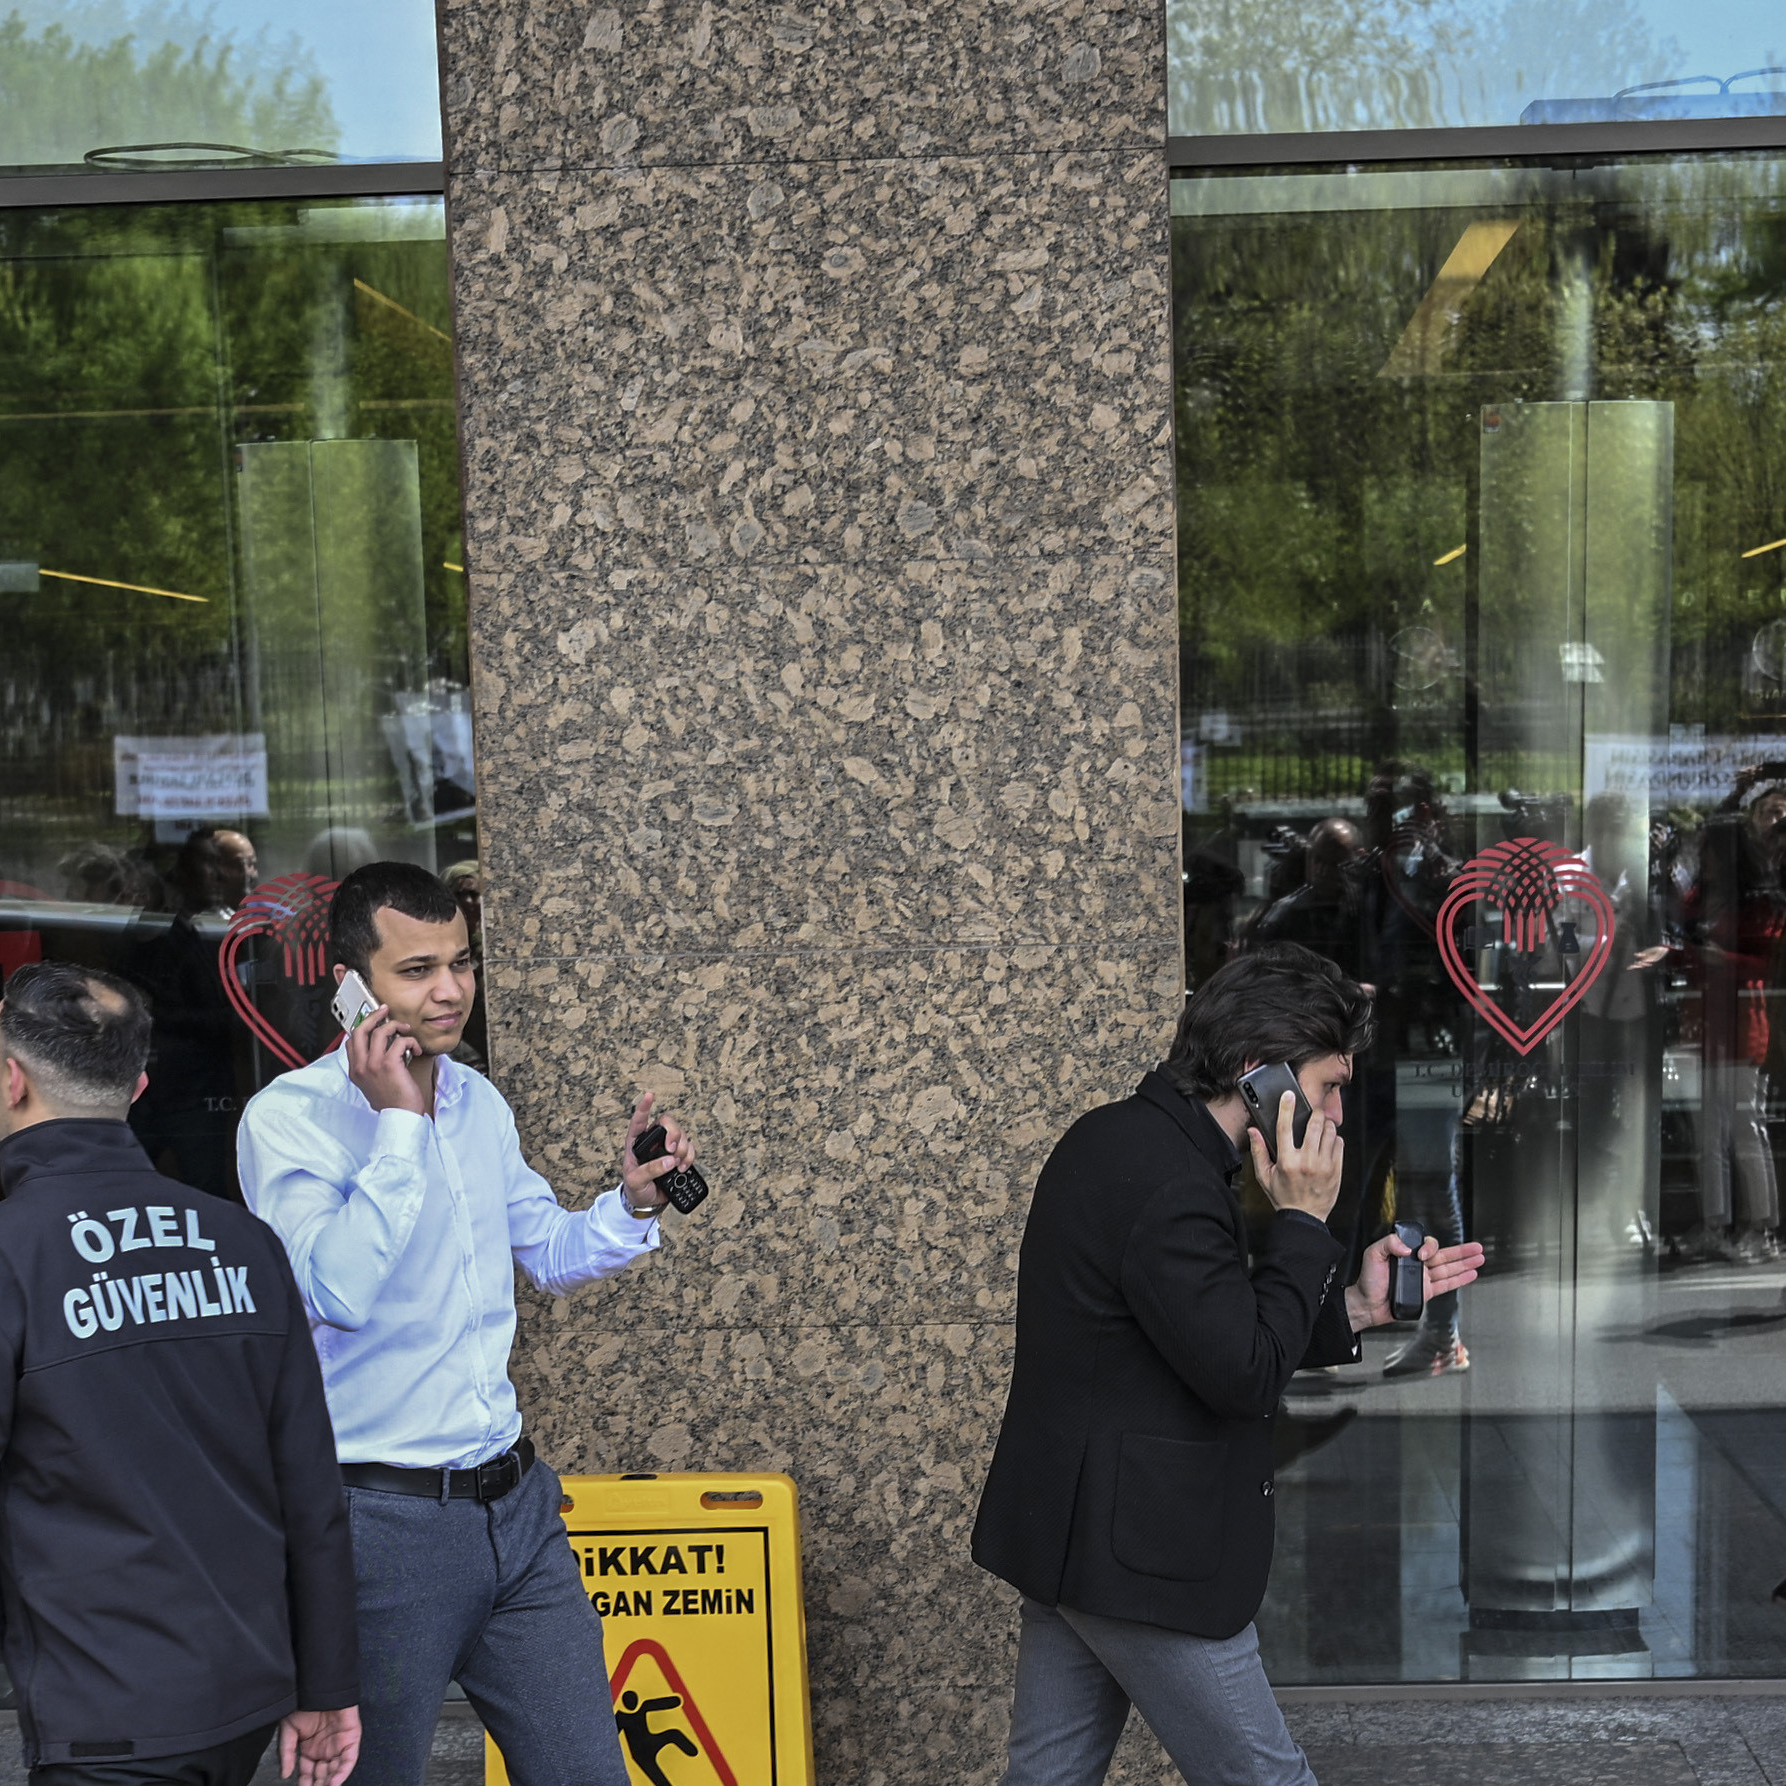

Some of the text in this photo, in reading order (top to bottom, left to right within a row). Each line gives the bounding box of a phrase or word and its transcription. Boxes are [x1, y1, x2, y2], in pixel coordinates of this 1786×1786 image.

[204, 1096, 237, 1112] T.C.
[67, 1206, 215, 1264] ÖZEL
[63, 1256, 257, 1339] GÜVENLİK
[587, 1589, 653, 1617] GAN
